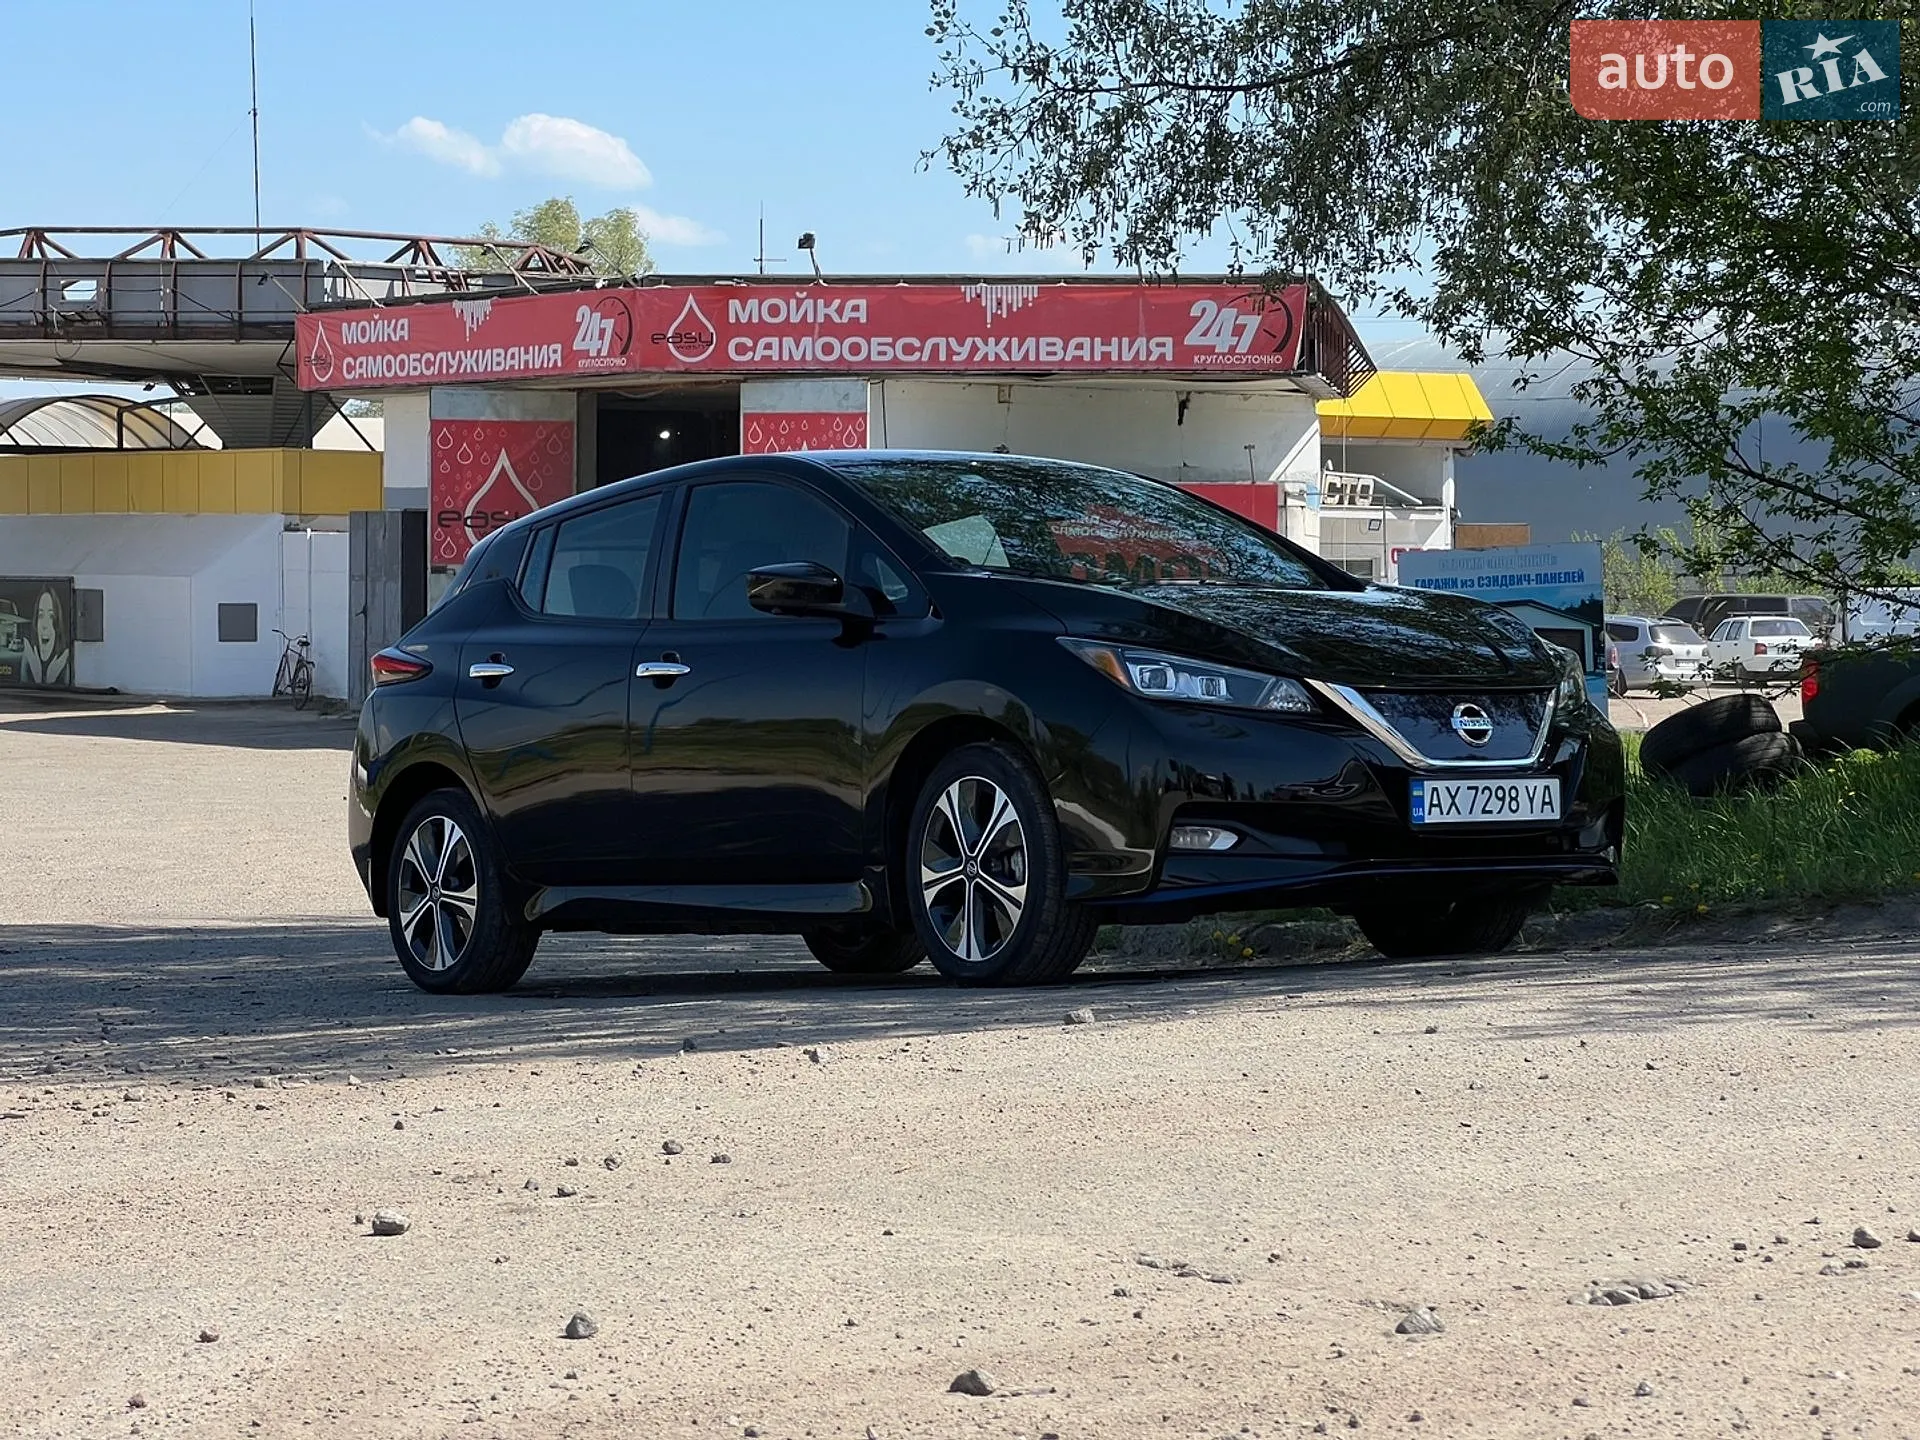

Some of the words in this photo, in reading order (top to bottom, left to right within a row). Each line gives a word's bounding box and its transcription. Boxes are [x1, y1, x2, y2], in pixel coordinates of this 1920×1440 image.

[728, 291, 867, 324] МОЙКА
[341, 314, 409, 345] МОЙКА
[651, 332, 714, 346] easy
[728, 336, 1173, 362] САМООБСЛУЖИВАНИЯ
[1193, 354, 1283, 366] КРУГЛОСУТОЧНО
[342, 343, 562, 380] САМООБСЛУЖИВАНИЯ
[1323, 474, 1375, 506] СТО
[437, 511, 519, 529] eas
[1461, 579, 1475, 589] из
[1477, 568, 1585, 589] СЭНДВИЧ-ПАНЕЛЕЙ
[1412, 807, 1424, 817] UA
